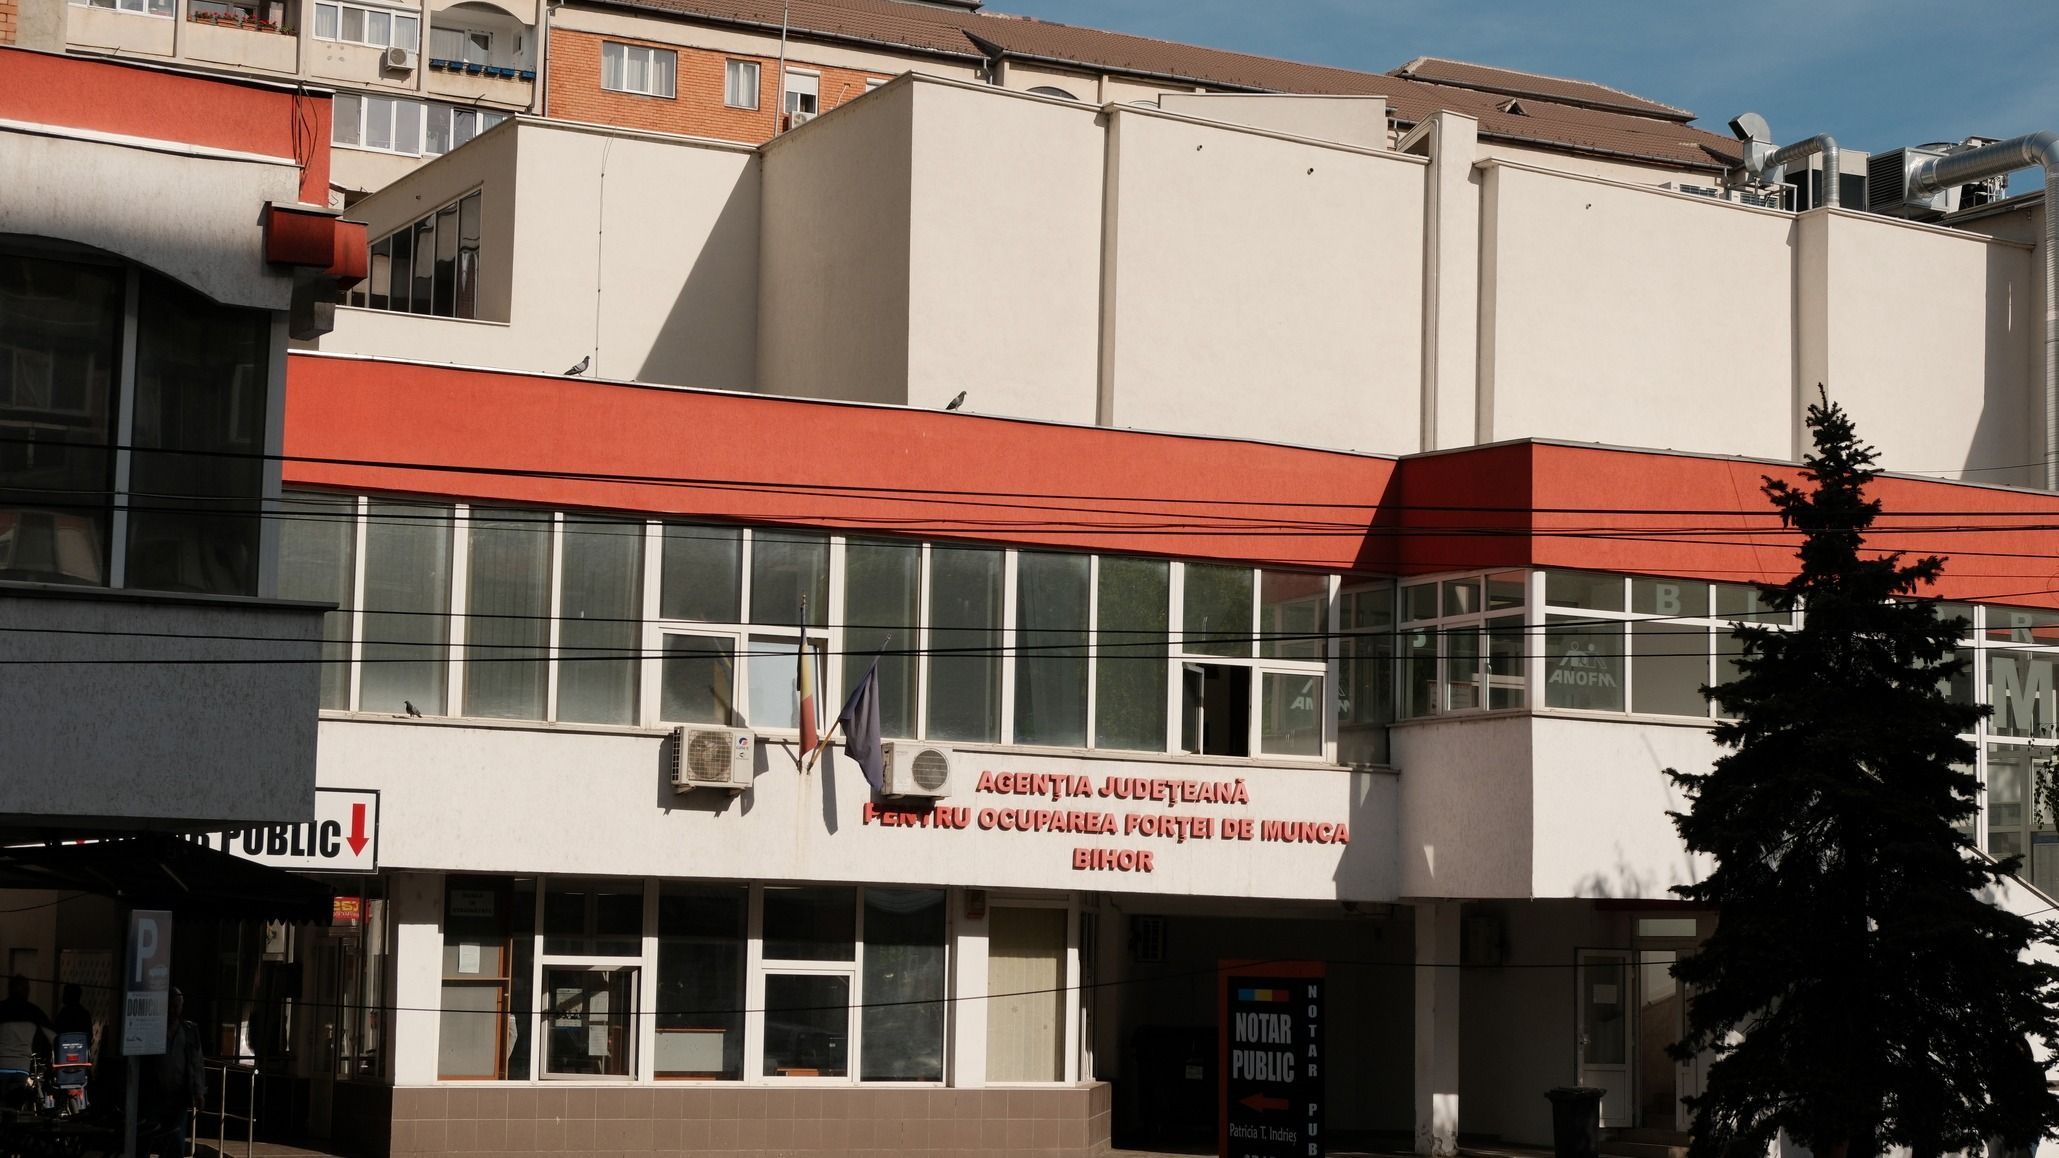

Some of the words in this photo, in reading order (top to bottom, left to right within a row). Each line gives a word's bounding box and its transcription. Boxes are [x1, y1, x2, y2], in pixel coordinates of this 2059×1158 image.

[1548, 669, 1617, 688] ANOFM
[220, 820, 342, 858] PUBLIC
[862, 802, 972, 830] PENTRU
[978, 807, 1119, 834] OCUPAREA
[1221, 818, 1255, 841] DE
[1261, 820, 1349, 845] MUNCA
[1072, 847, 1155, 873] BIHOR
[135, 918, 158, 982] P
[1235, 1012, 1292, 1044] NOTAR
[1232, 1049, 1295, 1083] PUBLIC
[1229, 1123, 1258, 1139] Patricia
